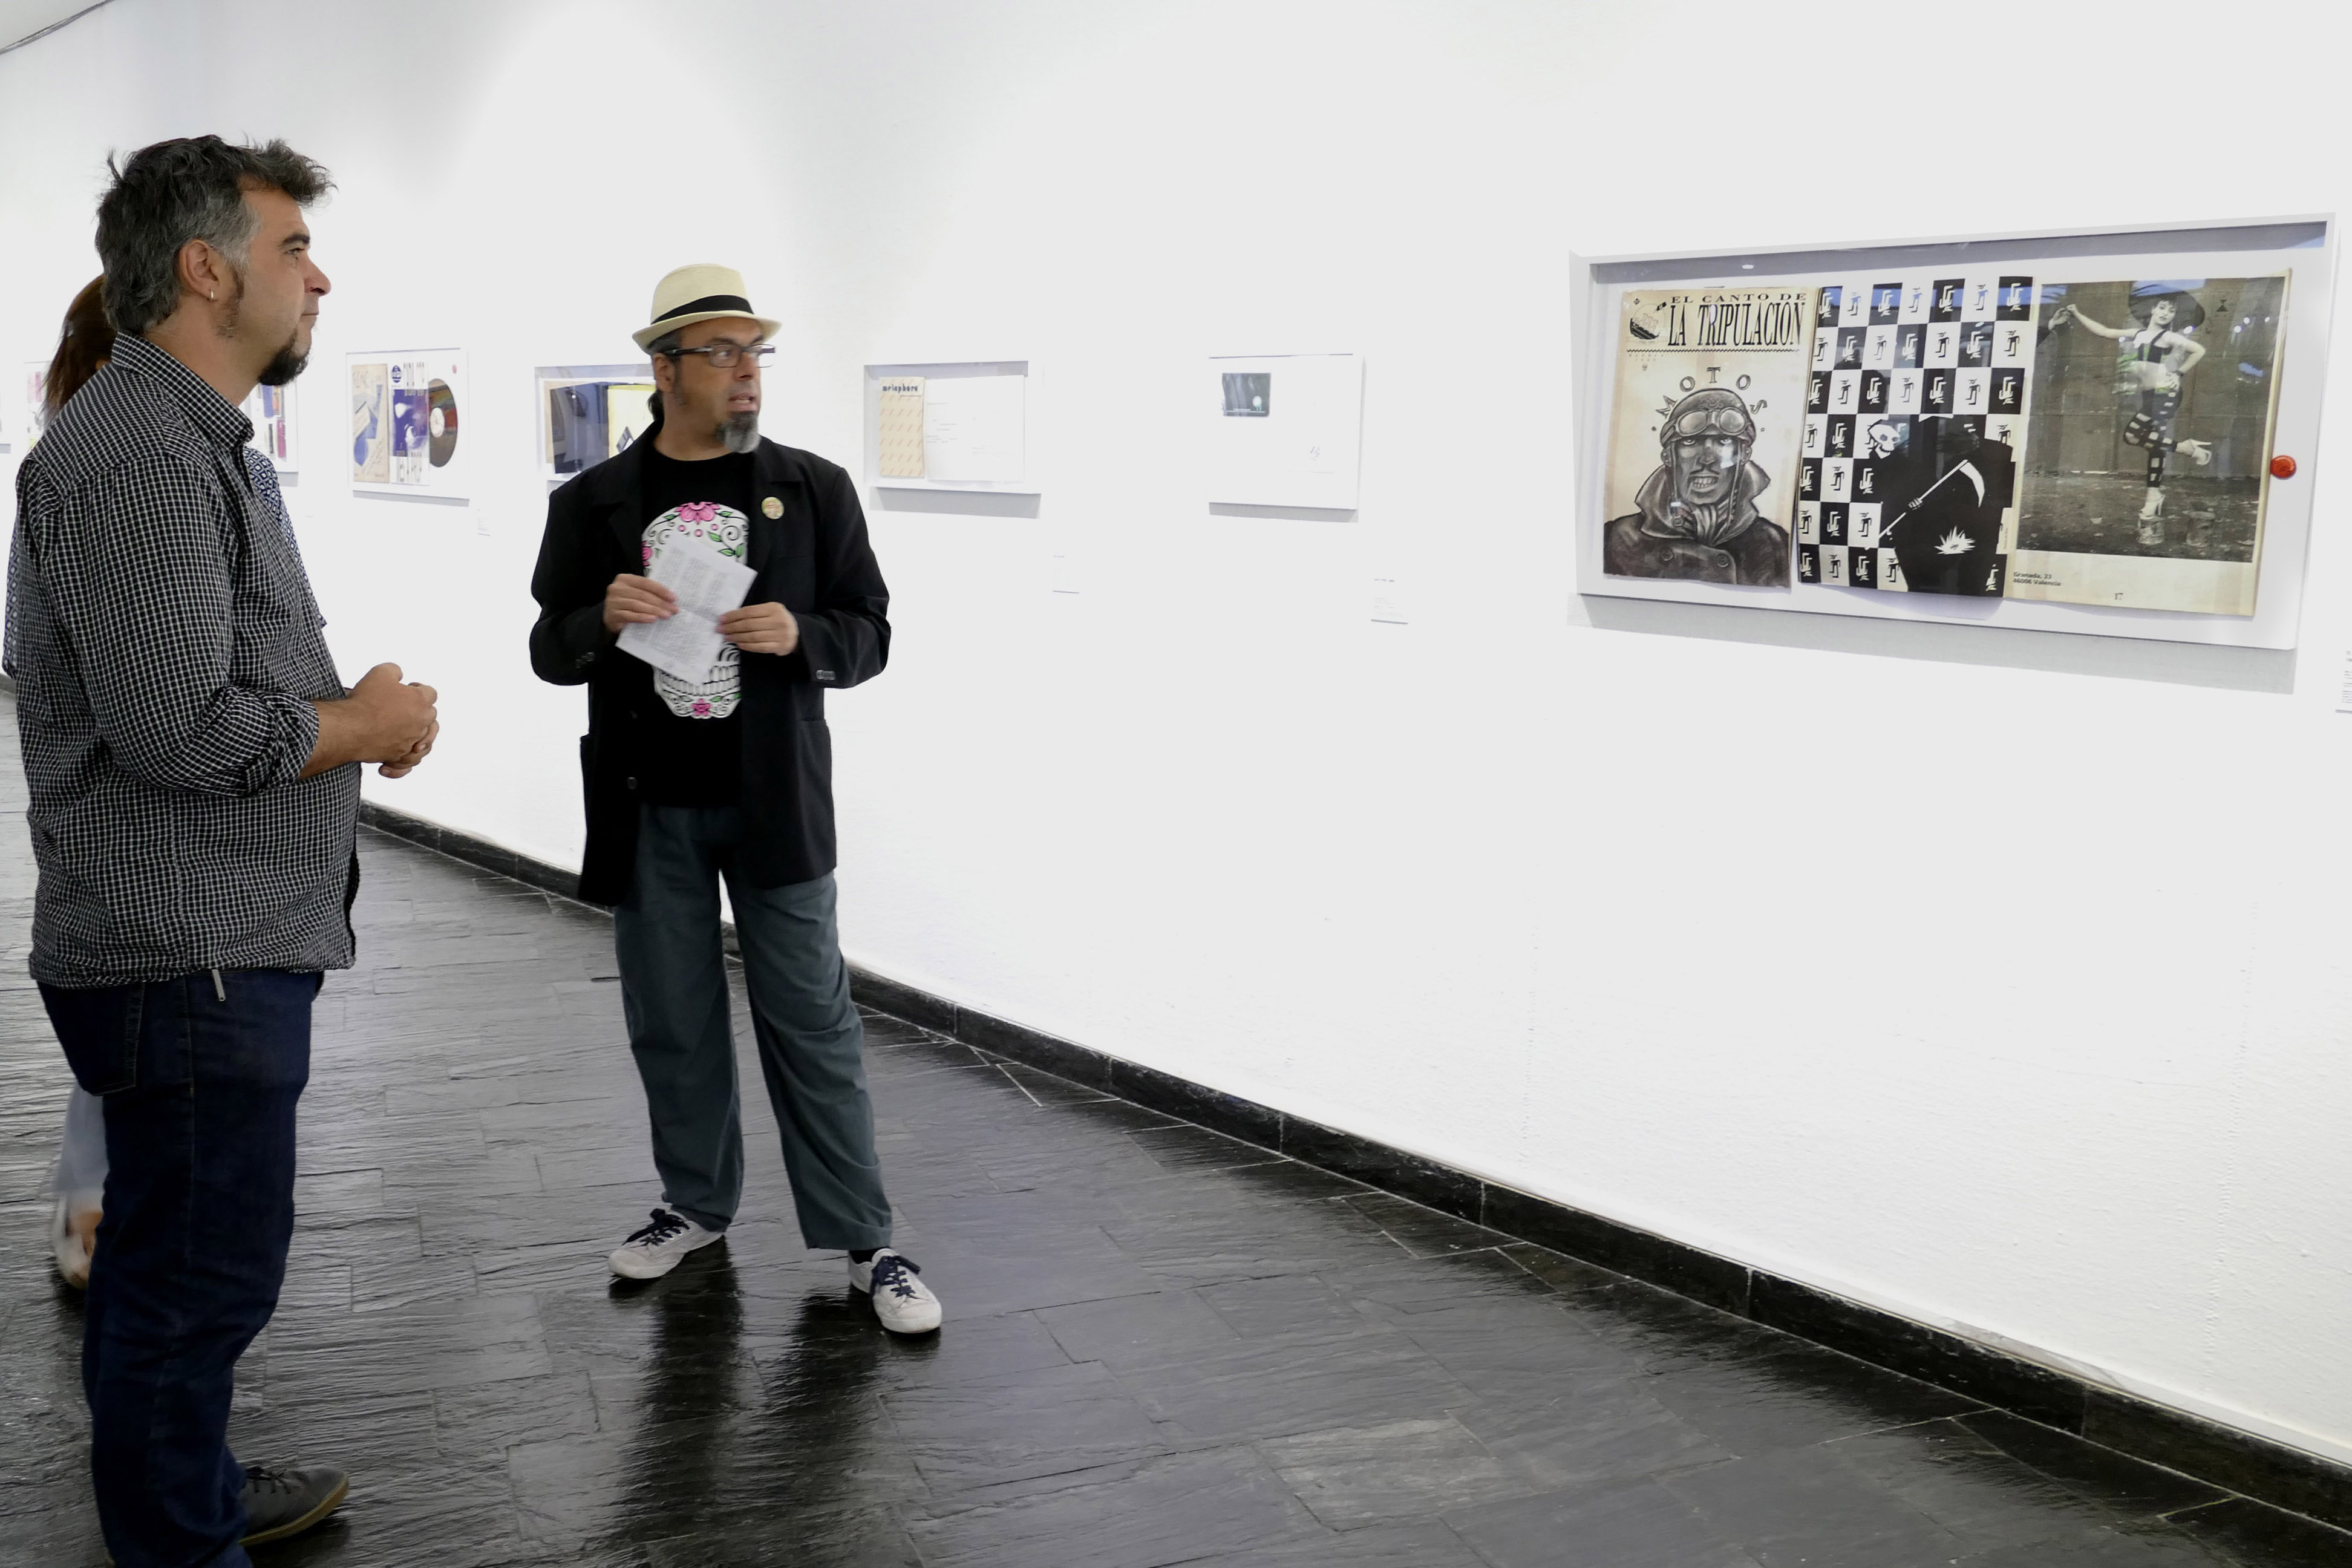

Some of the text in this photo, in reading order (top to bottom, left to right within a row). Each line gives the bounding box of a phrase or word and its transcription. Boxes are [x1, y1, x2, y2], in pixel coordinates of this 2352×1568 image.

[1671, 293, 1807, 304] EL CANTO DE
[1668, 304, 1687, 346] LA
